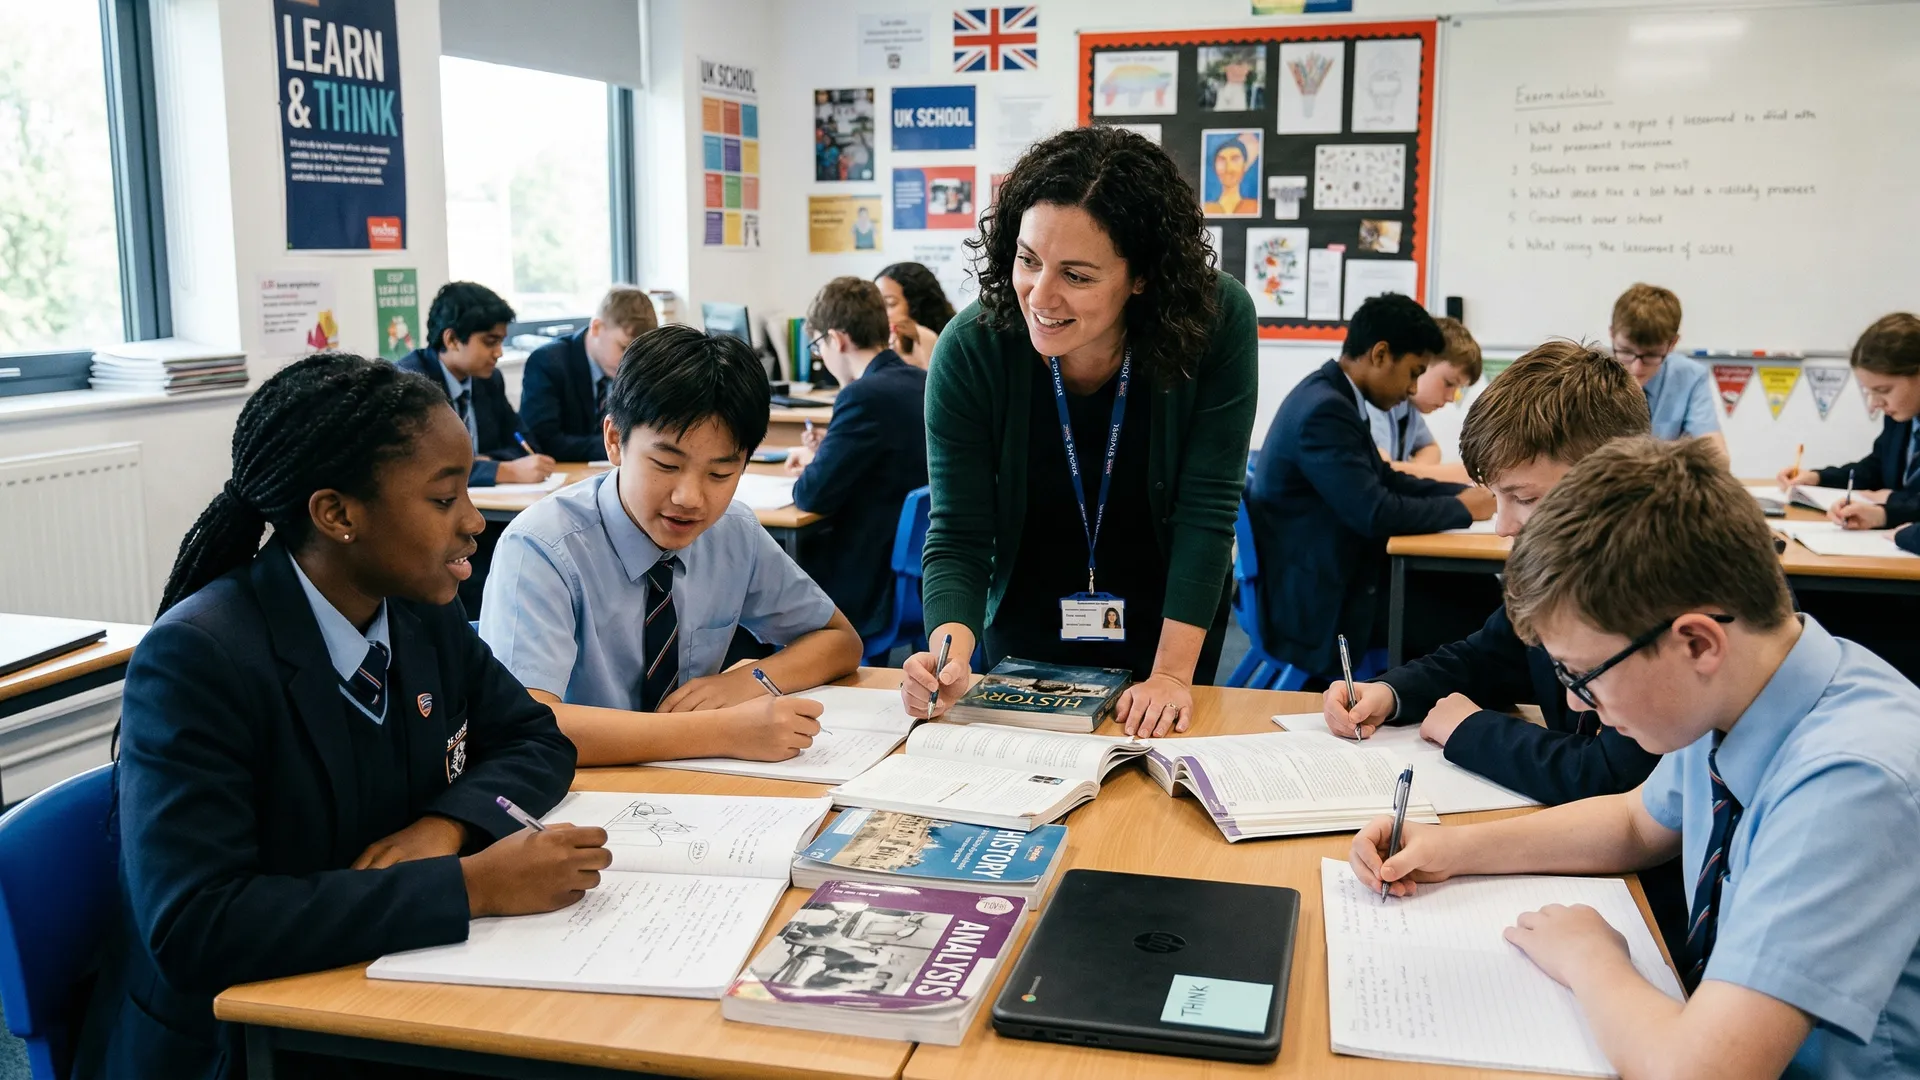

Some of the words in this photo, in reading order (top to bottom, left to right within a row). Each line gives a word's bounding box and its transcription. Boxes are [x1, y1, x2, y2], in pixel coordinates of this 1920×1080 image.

[283, 14, 385, 82] LEARN
[700, 60, 716, 84] UK
[718, 64, 757, 93] SCHOOL
[287, 77, 312, 129] &
[312, 79, 398, 137] THINK
[894, 107, 914, 128] UK
[916, 106, 974, 128] SCHOOL
[1529, 121, 1561, 135] What
[1529, 187, 1561, 200] What
[1526, 236, 1556, 251] What
[971, 691, 1083, 709] HISTORY
[972, 829, 1027, 879] HISTORY
[915, 919, 990, 997] ANALYSIS
[1181, 984, 1209, 1017] THINK
